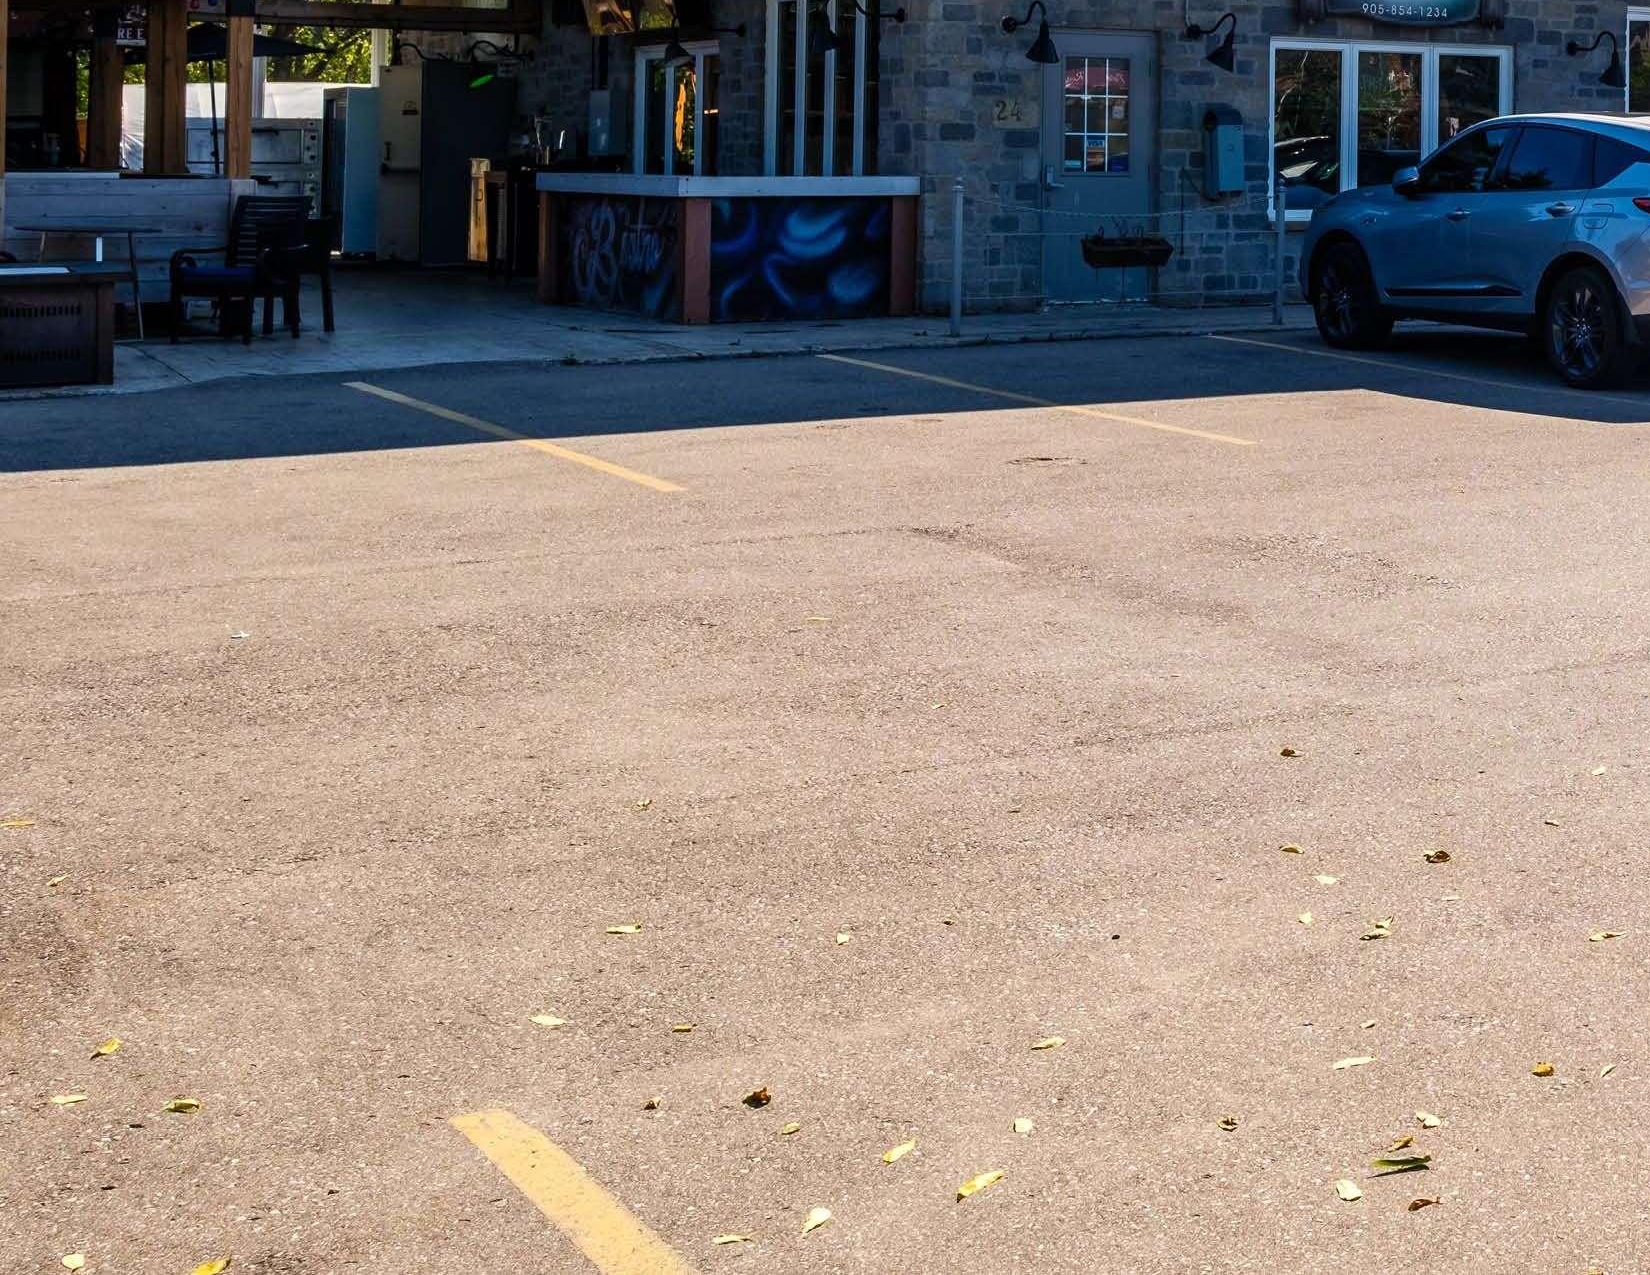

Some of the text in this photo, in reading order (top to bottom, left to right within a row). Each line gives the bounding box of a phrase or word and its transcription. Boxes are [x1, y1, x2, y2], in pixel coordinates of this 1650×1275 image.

[1361, 3, 1448, 18] 905-854-1234
[995, 100, 1024, 122] 24
[1088, 139, 1104, 147] VISA
